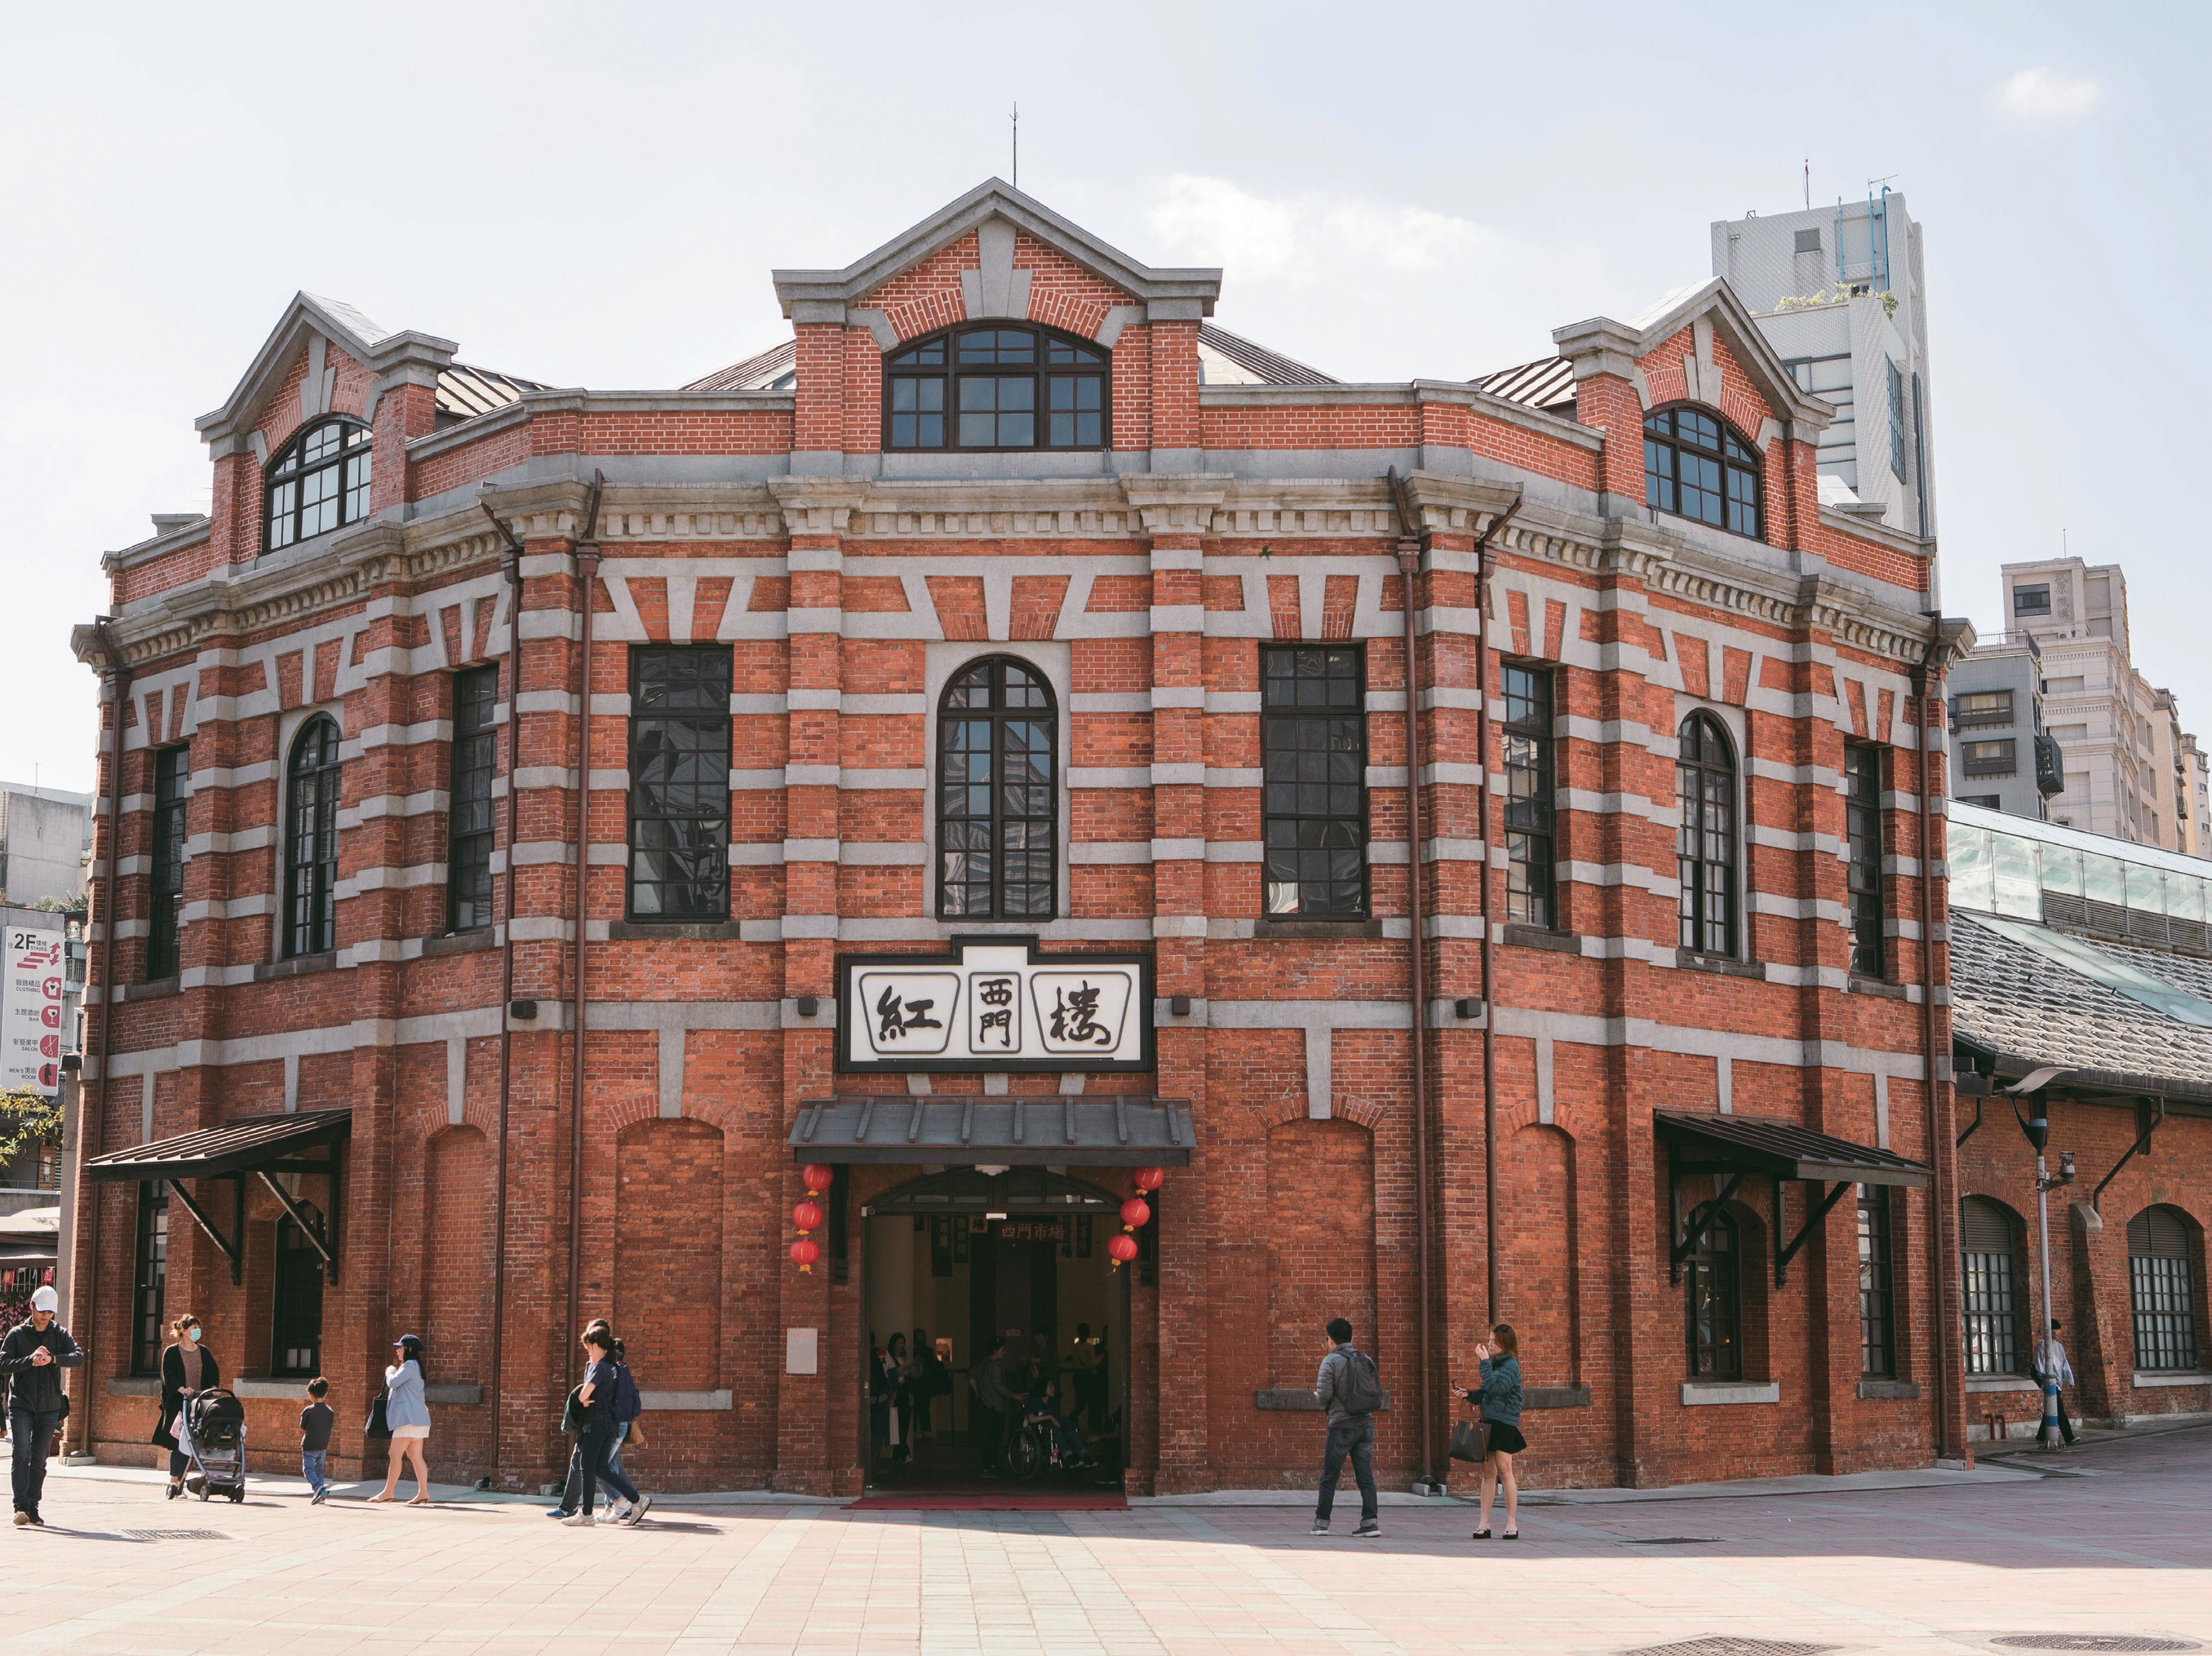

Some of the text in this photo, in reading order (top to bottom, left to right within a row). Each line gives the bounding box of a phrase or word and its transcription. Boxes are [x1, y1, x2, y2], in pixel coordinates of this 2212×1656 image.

[14, 932, 37, 950] 2F
[16, 979, 41, 987] 服飾精品
[14, 1008, 39, 1016] 主題酒吧
[876, 985, 943, 1042] 紅
[978, 978, 1013, 1047] 西門
[1001, 1223, 1065, 1241] 西門市場
